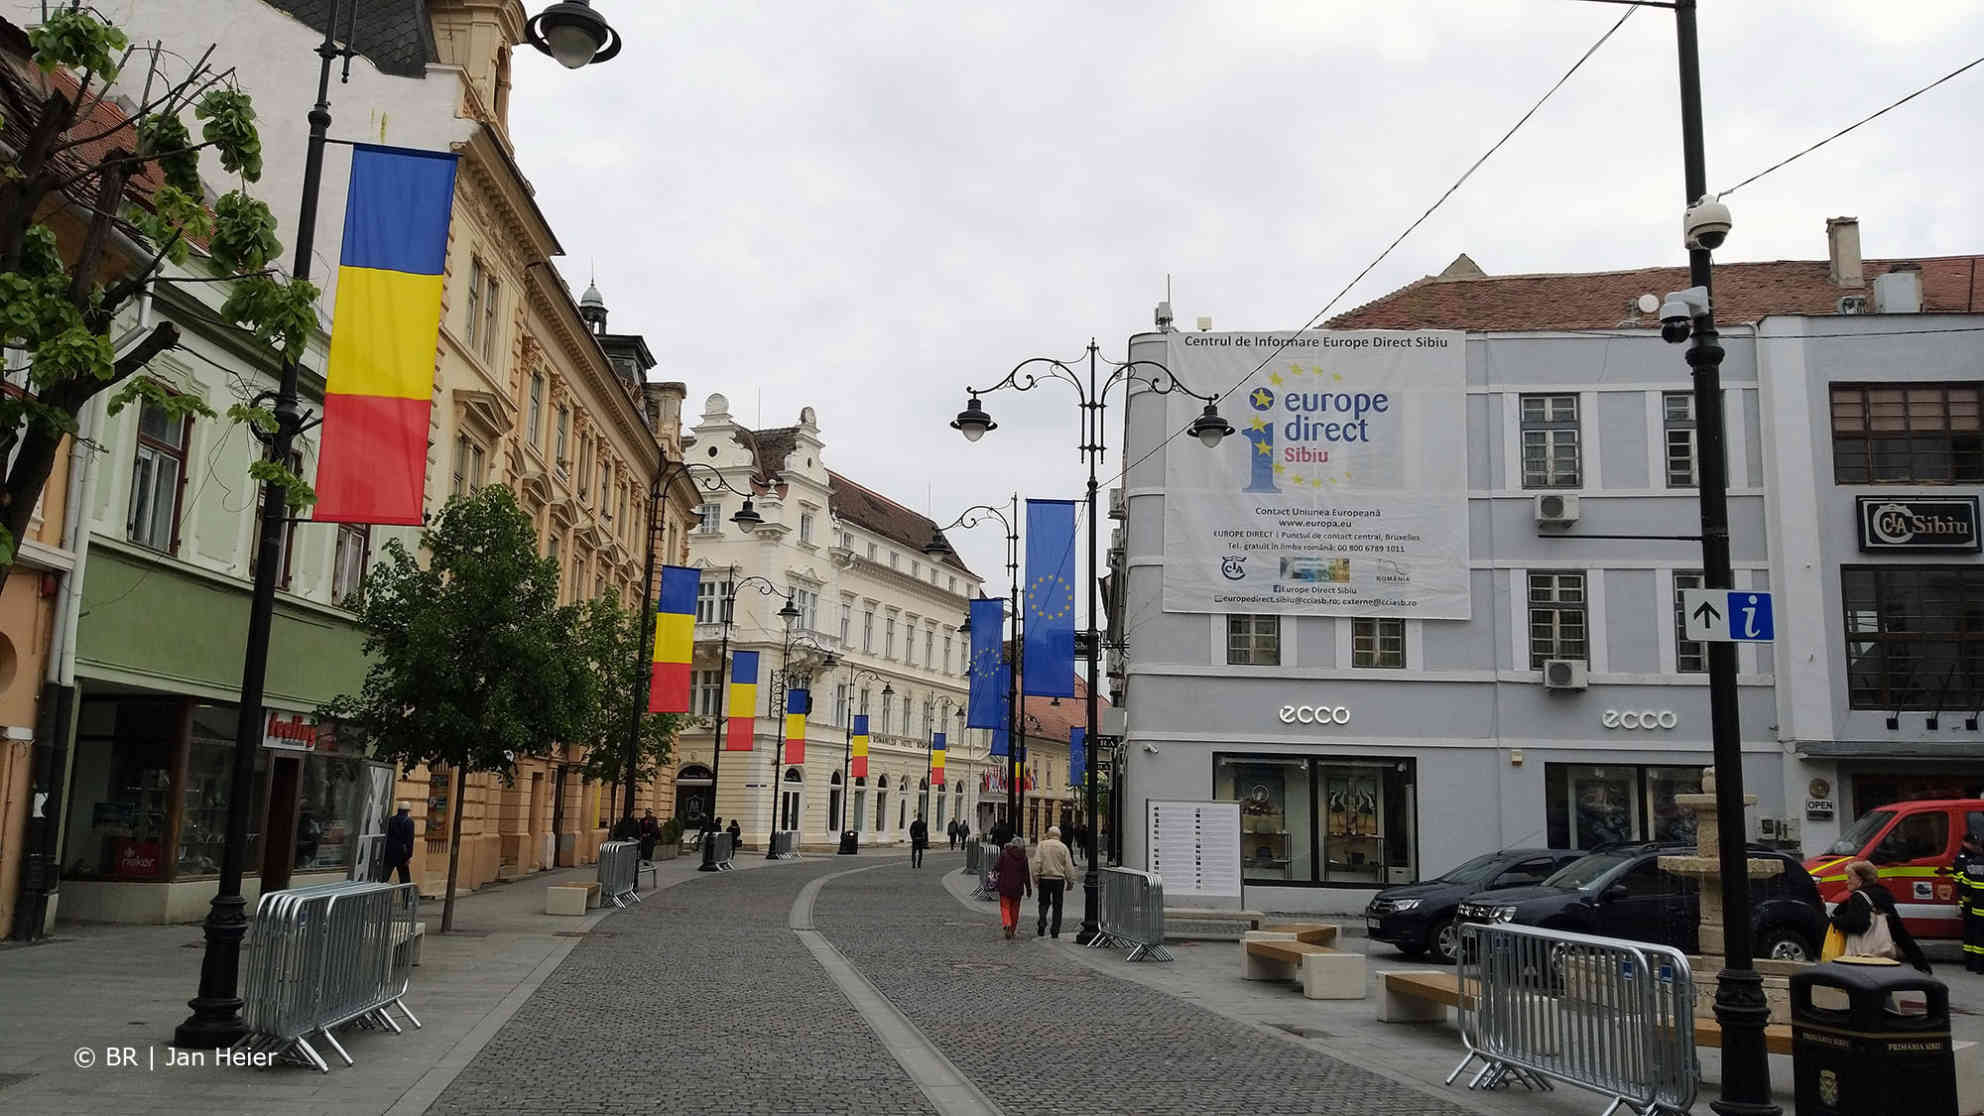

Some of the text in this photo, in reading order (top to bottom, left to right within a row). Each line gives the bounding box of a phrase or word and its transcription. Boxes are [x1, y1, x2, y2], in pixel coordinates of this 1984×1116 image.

[1184, 336, 1448, 349] Centrul de Informare Europe Direct Sibiu
[1284, 391, 1389, 420] europe
[1284, 414, 1369, 442] direct
[1284, 447, 1329, 463] Sibiu
[1255, 507, 1290, 517] Contact
[1292, 508, 1330, 517] Uniunea
[1279, 520, 1352, 529] www.europa.eu
[1912, 514, 1969, 534] Sibiu
[1214, 530, 1244, 538] EUROPE
[1228, 542, 1242, 550] Tel.
[1312, 586, 1336, 594] Direct
[1279, 705, 1351, 724] ecco
[1602, 710, 1678, 729] ecco
[1807, 801, 1833, 810] OPEN
